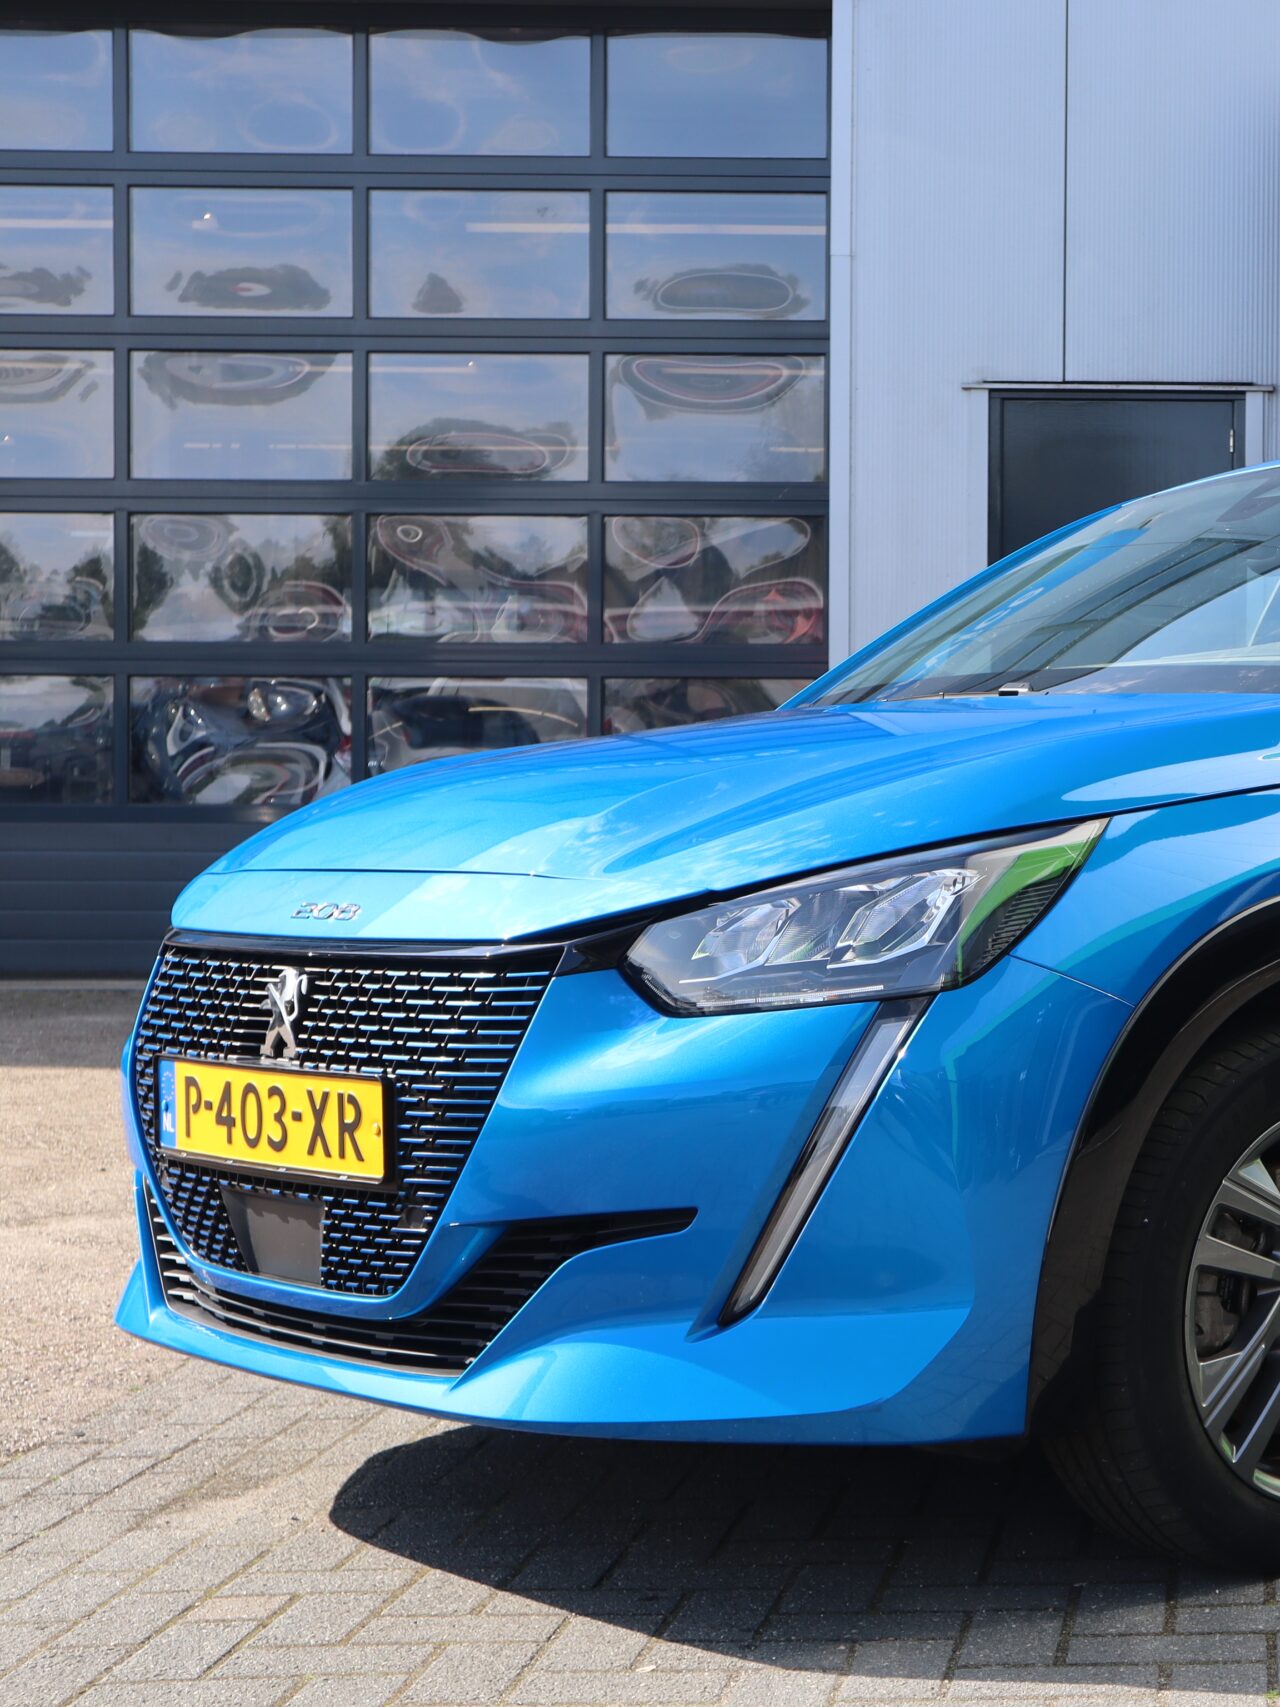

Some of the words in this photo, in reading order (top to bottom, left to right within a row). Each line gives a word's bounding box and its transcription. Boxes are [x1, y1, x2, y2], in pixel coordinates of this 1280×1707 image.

[290, 901, 361, 921] 208
[162, 1113, 176, 1133] NL
[184, 1075, 365, 1162] P-403-XR
